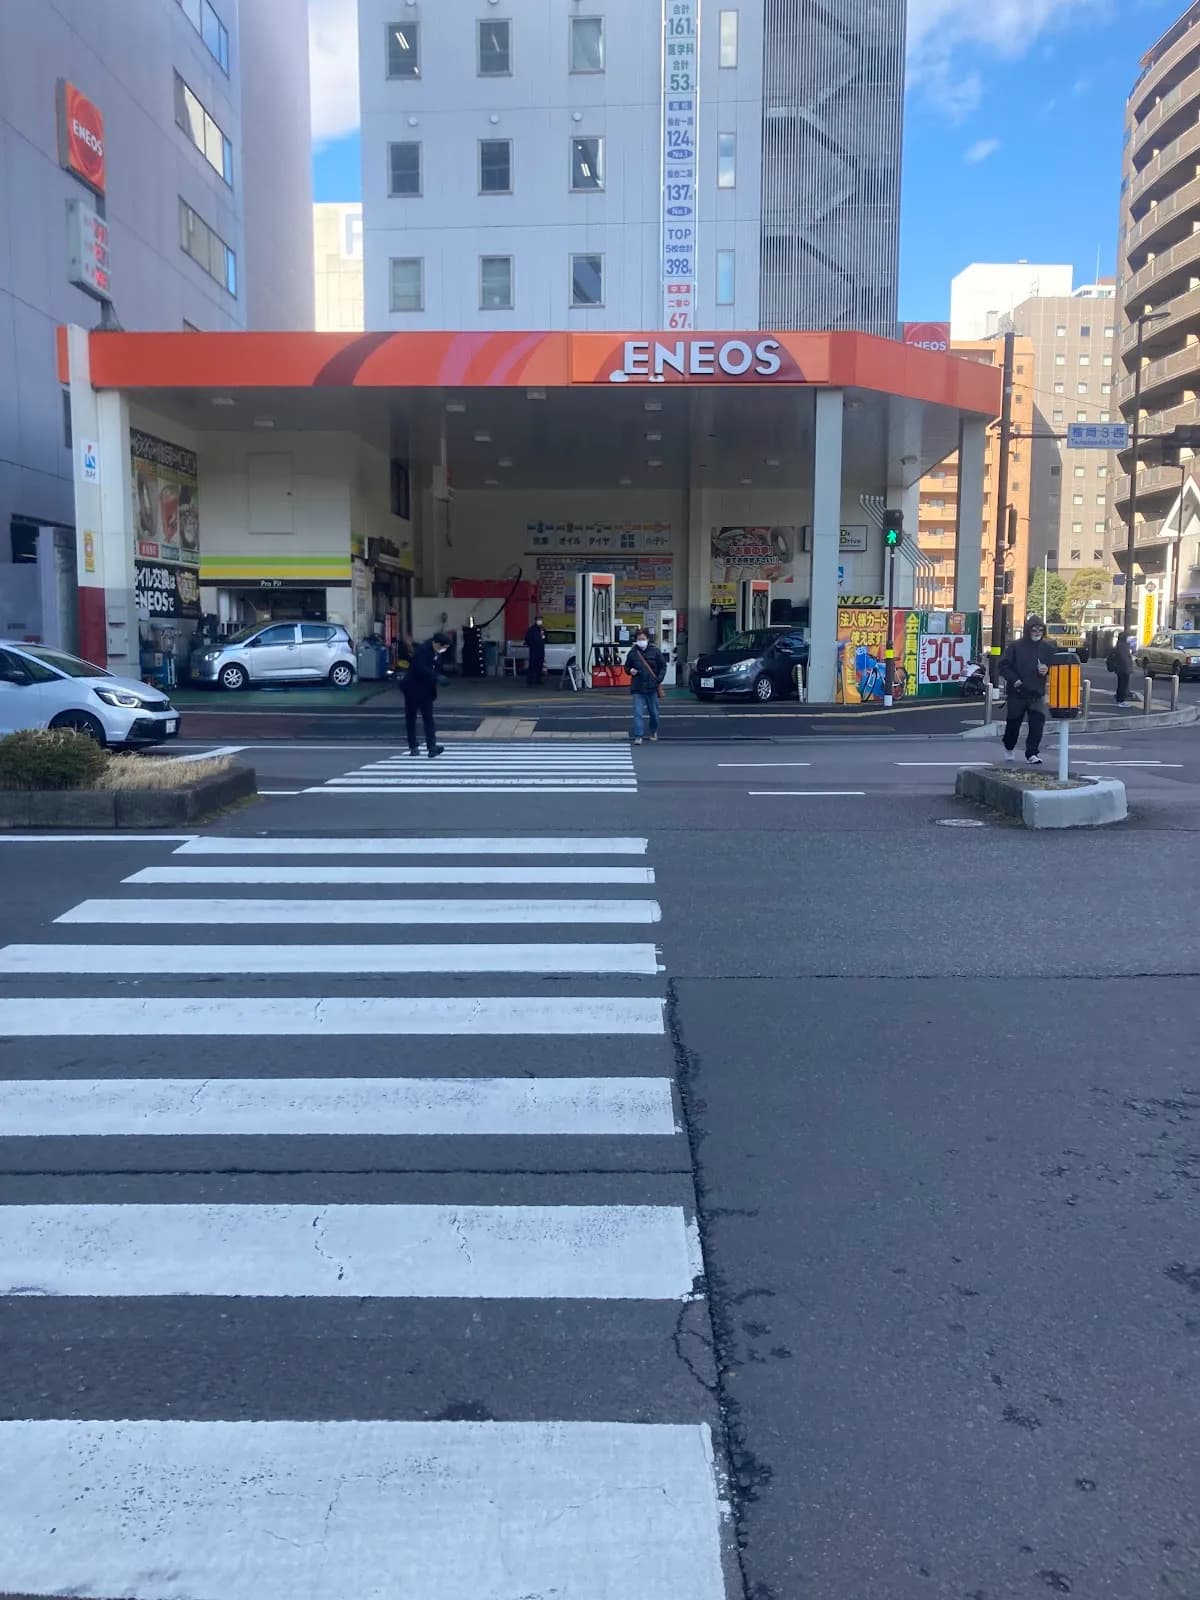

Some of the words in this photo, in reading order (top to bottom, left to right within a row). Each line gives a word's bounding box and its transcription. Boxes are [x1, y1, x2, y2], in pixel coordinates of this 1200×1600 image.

[73, 119, 103, 157] ENEOS
[667, 229, 692, 240] TOP
[623, 340, 781, 375] ENEOS
[837, 596, 885, 605] NLOP
[839, 611, 888, 628] 法人様カード
[927, 637, 964, 681] 205
